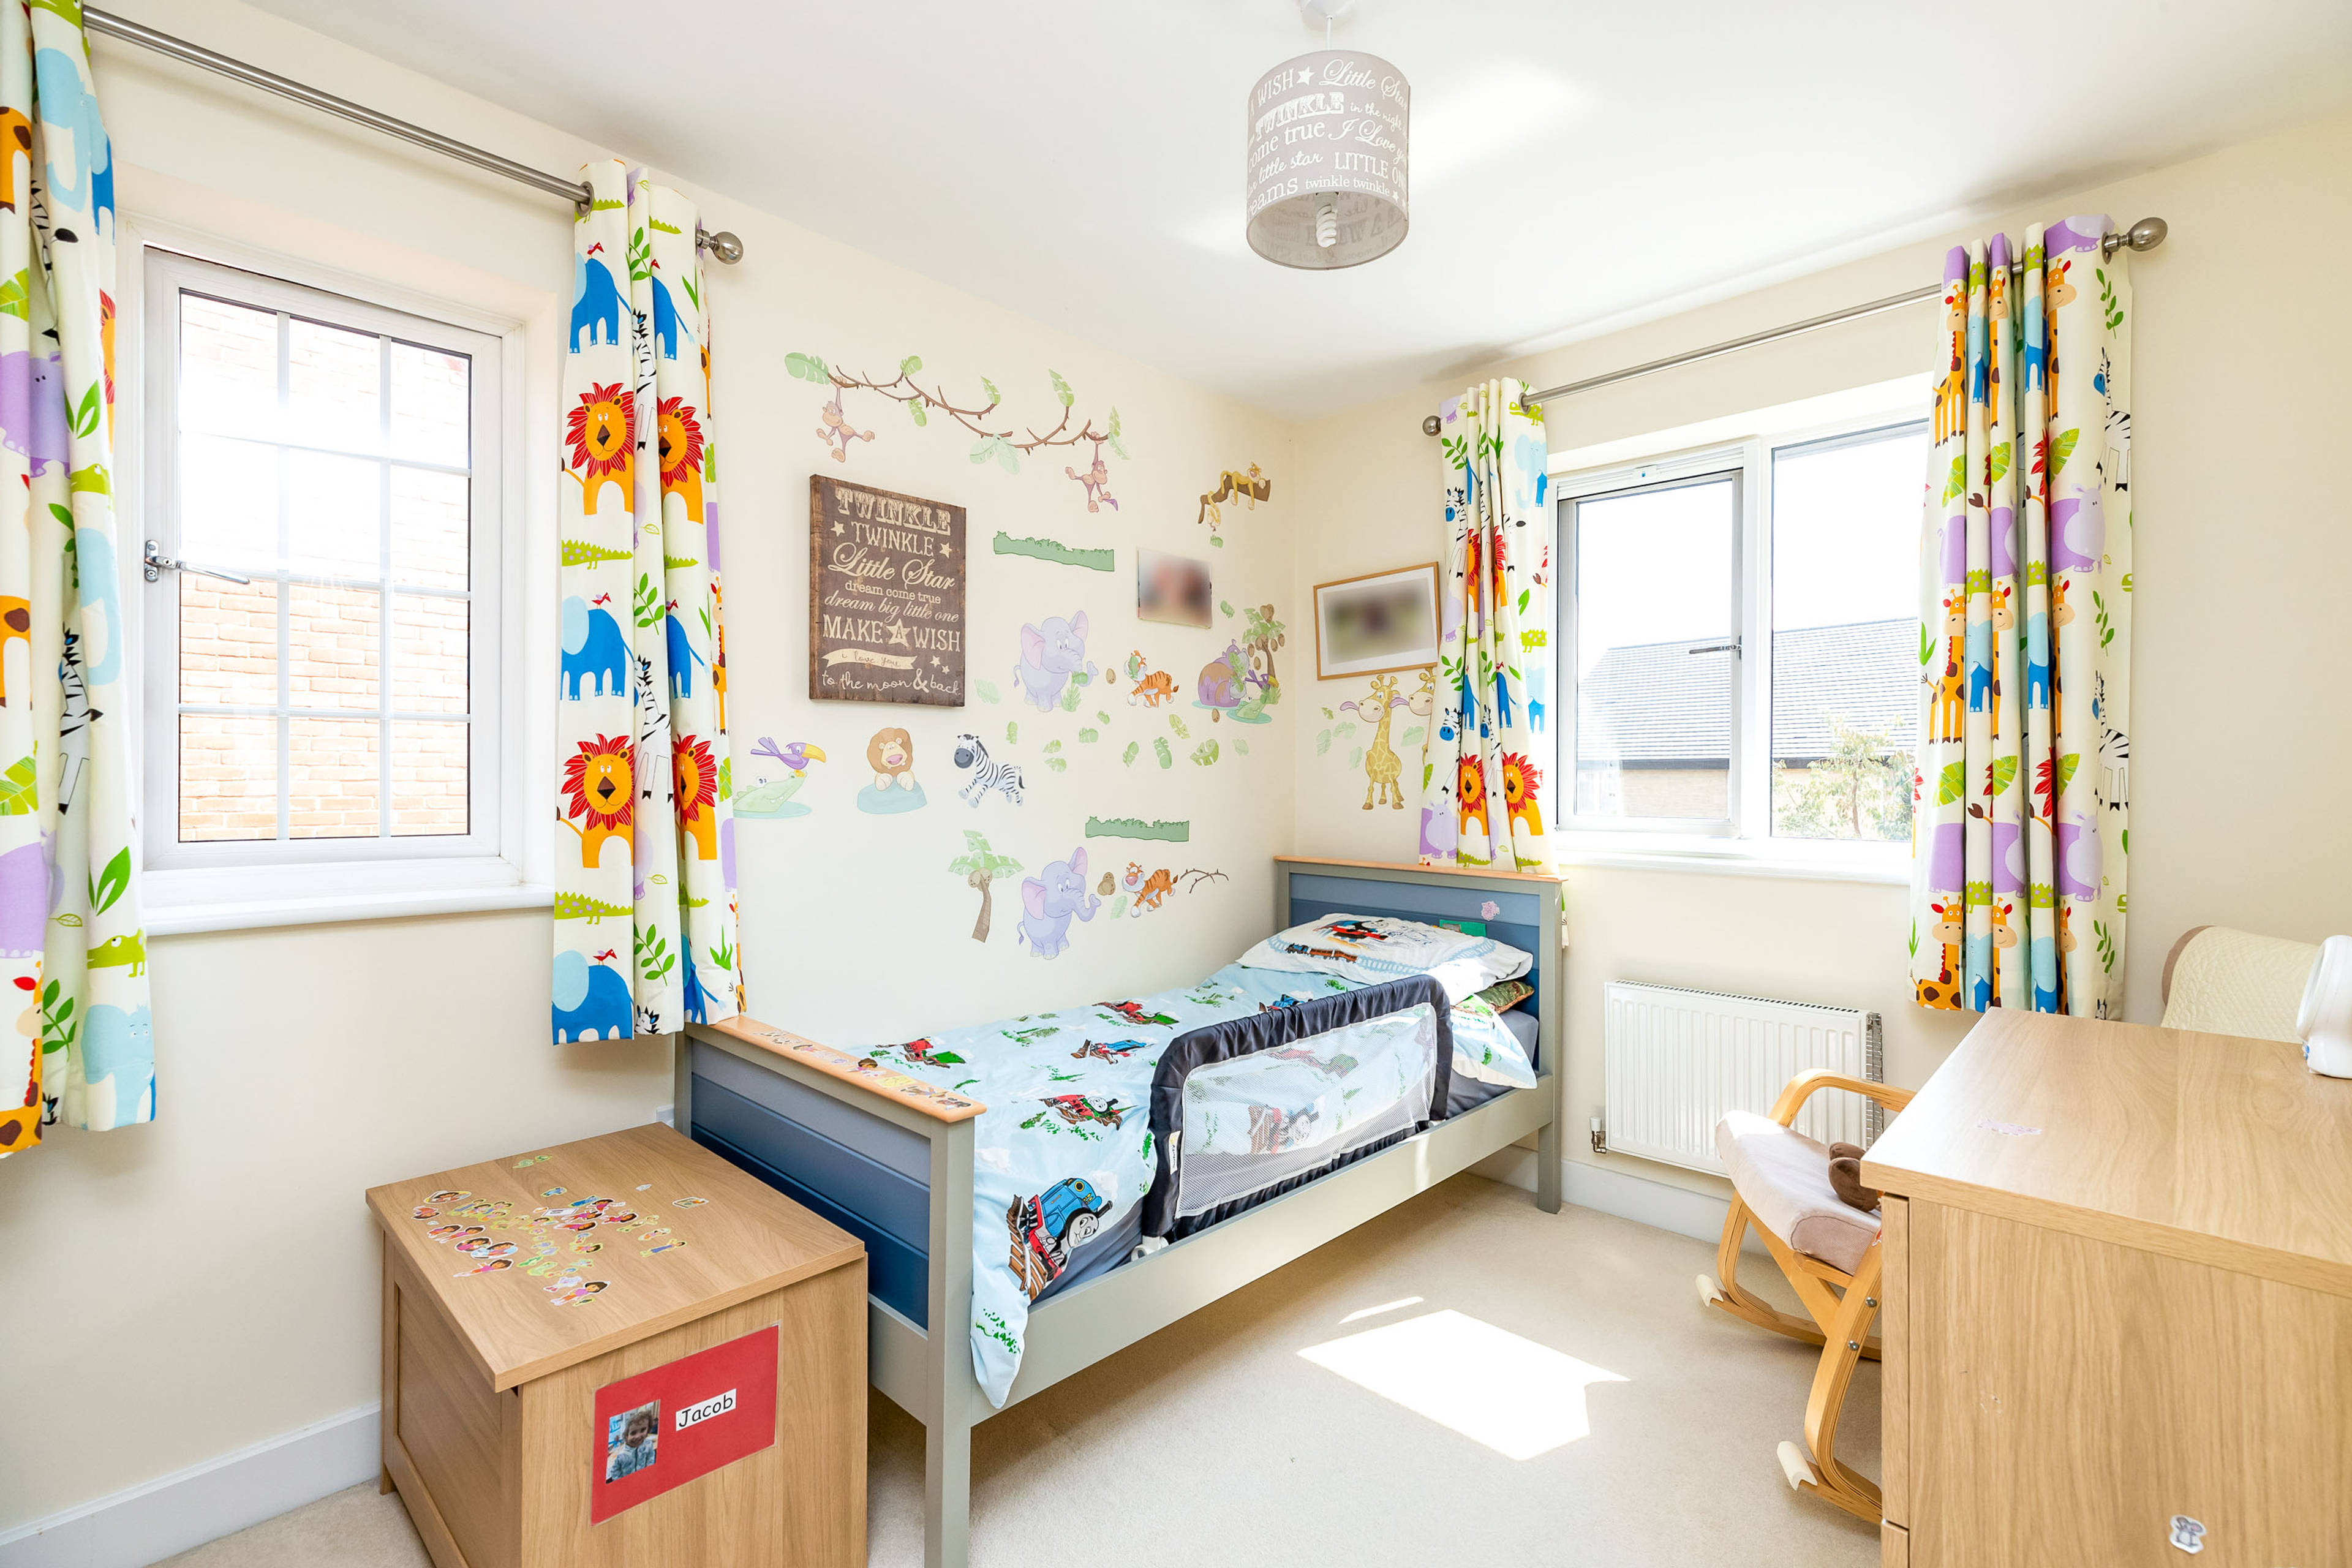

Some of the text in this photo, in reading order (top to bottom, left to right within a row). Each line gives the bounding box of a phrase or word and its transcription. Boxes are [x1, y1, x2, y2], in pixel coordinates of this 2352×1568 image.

[1257, 68, 1294, 107] WISH
[1319, 59, 1408, 111] Little Star
[1256, 92, 1344, 141] TWINKLE
[1351, 102, 1362, 113] in
[1365, 102, 1381, 116] the
[1249, 122, 1325, 173] come true
[1355, 119, 1396, 152] Love
[1259, 150, 1323, 184] little star
[1334, 151, 1389, 179] LITTLE
[1305, 175, 1390, 197] twinkle twinkle
[835, 487, 951, 536] TWINKLE
[851, 521, 934, 557] TWINKLE
[827, 542, 956, 590] Little Star
[824, 590, 959, 623] dream big little one
[845, 580, 941, 604] dream come true
[823, 613, 960, 652] MAKE A WISH
[854, 650, 875, 663] love
[881, 656, 901, 666] you
[822, 670, 837, 686] to
[840, 671, 864, 690] the
[867, 679, 912, 691] moon
[913, 668, 929, 693] &
[679, 1395, 733, 1427] Jacob
